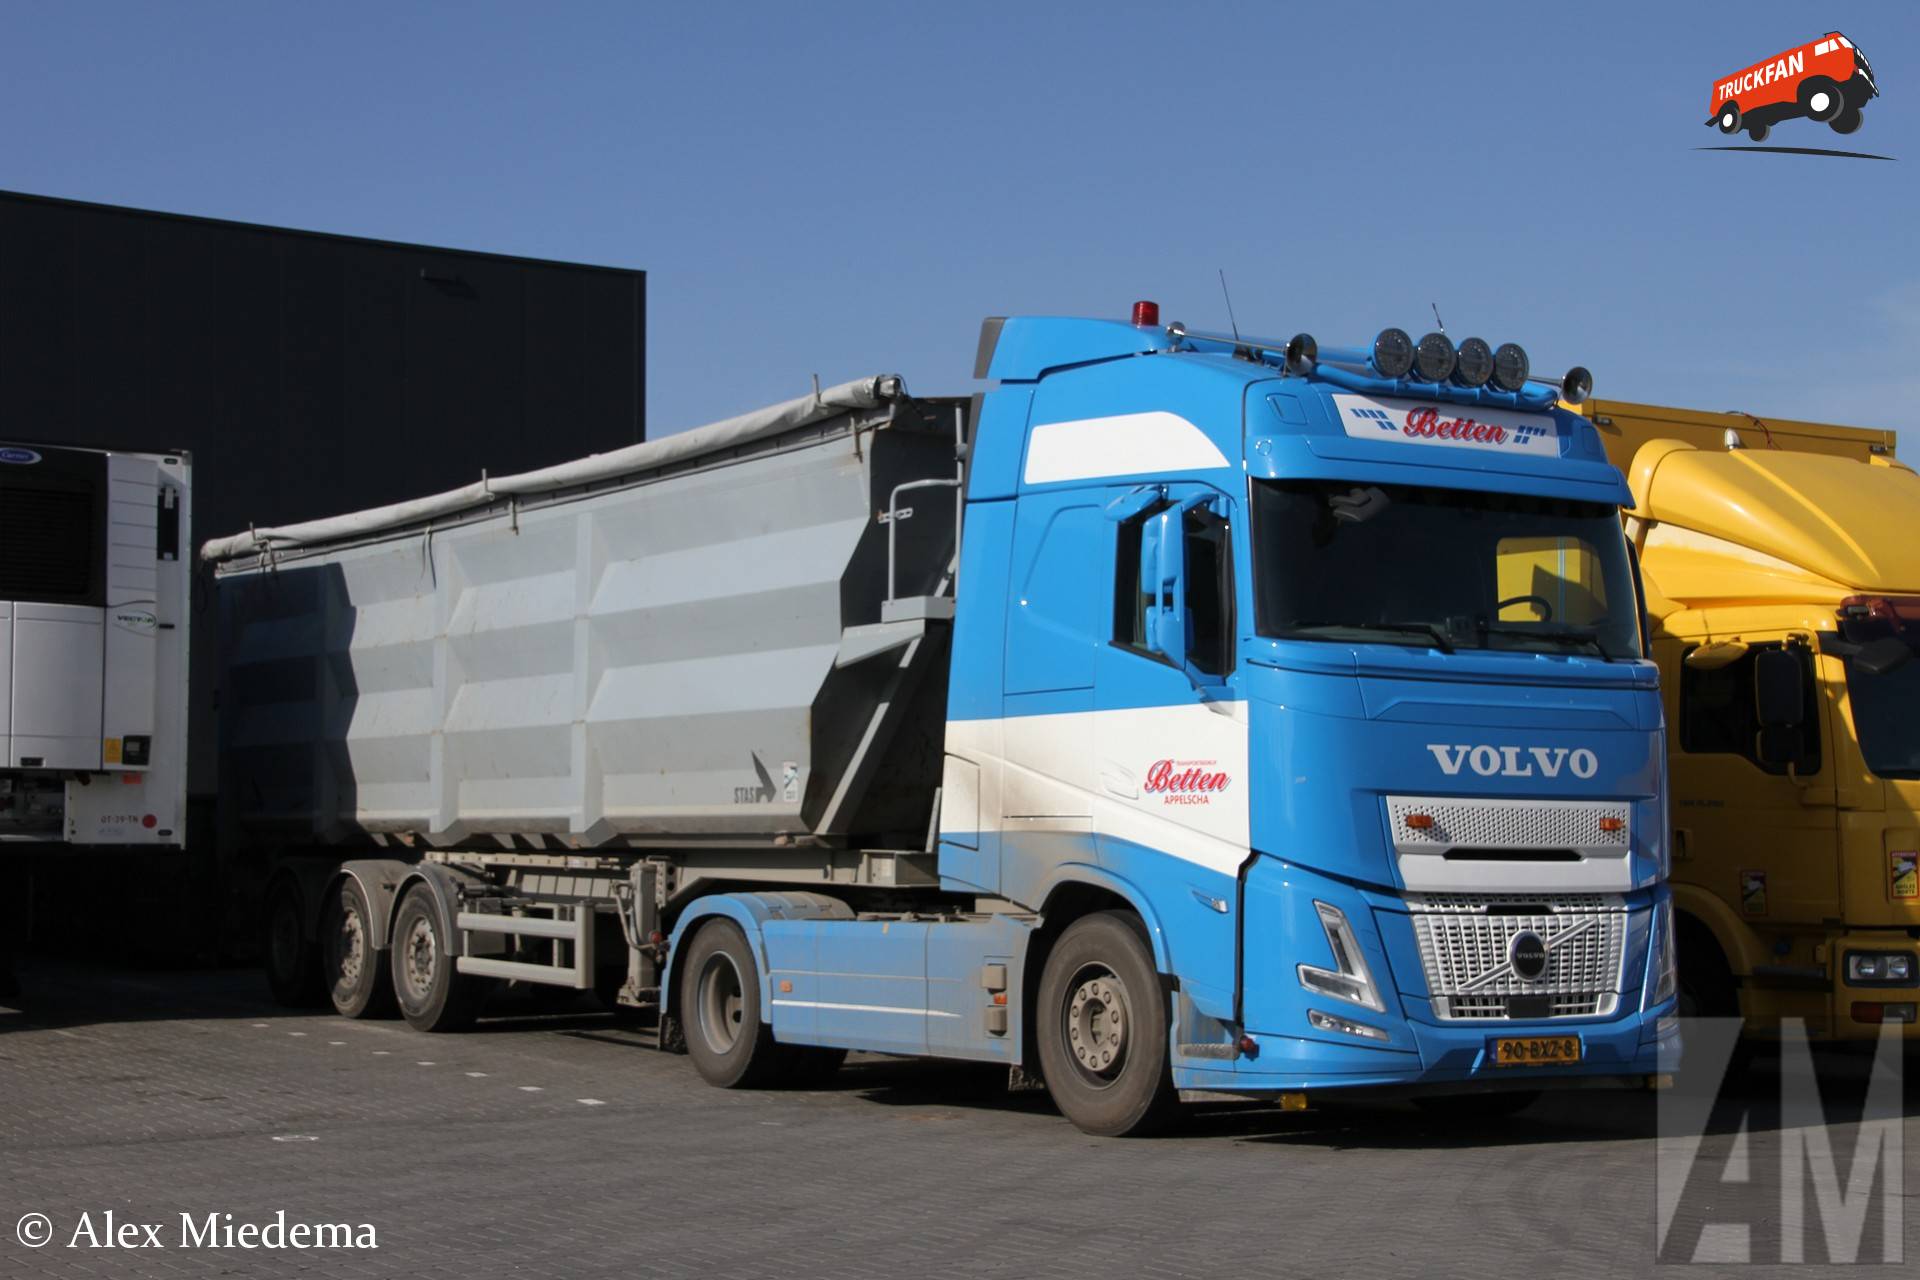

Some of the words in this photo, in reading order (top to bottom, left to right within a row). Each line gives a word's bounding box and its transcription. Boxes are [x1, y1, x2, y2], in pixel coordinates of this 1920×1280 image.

[1403, 406, 1507, 444] Betten
[1144, 759, 1231, 793] Betten
[1427, 744, 1598, 778] VOLVO
[1164, 794, 1209, 804] APPELSCHA
[1503, 1040, 1573, 1060] 90-BXZ-8
